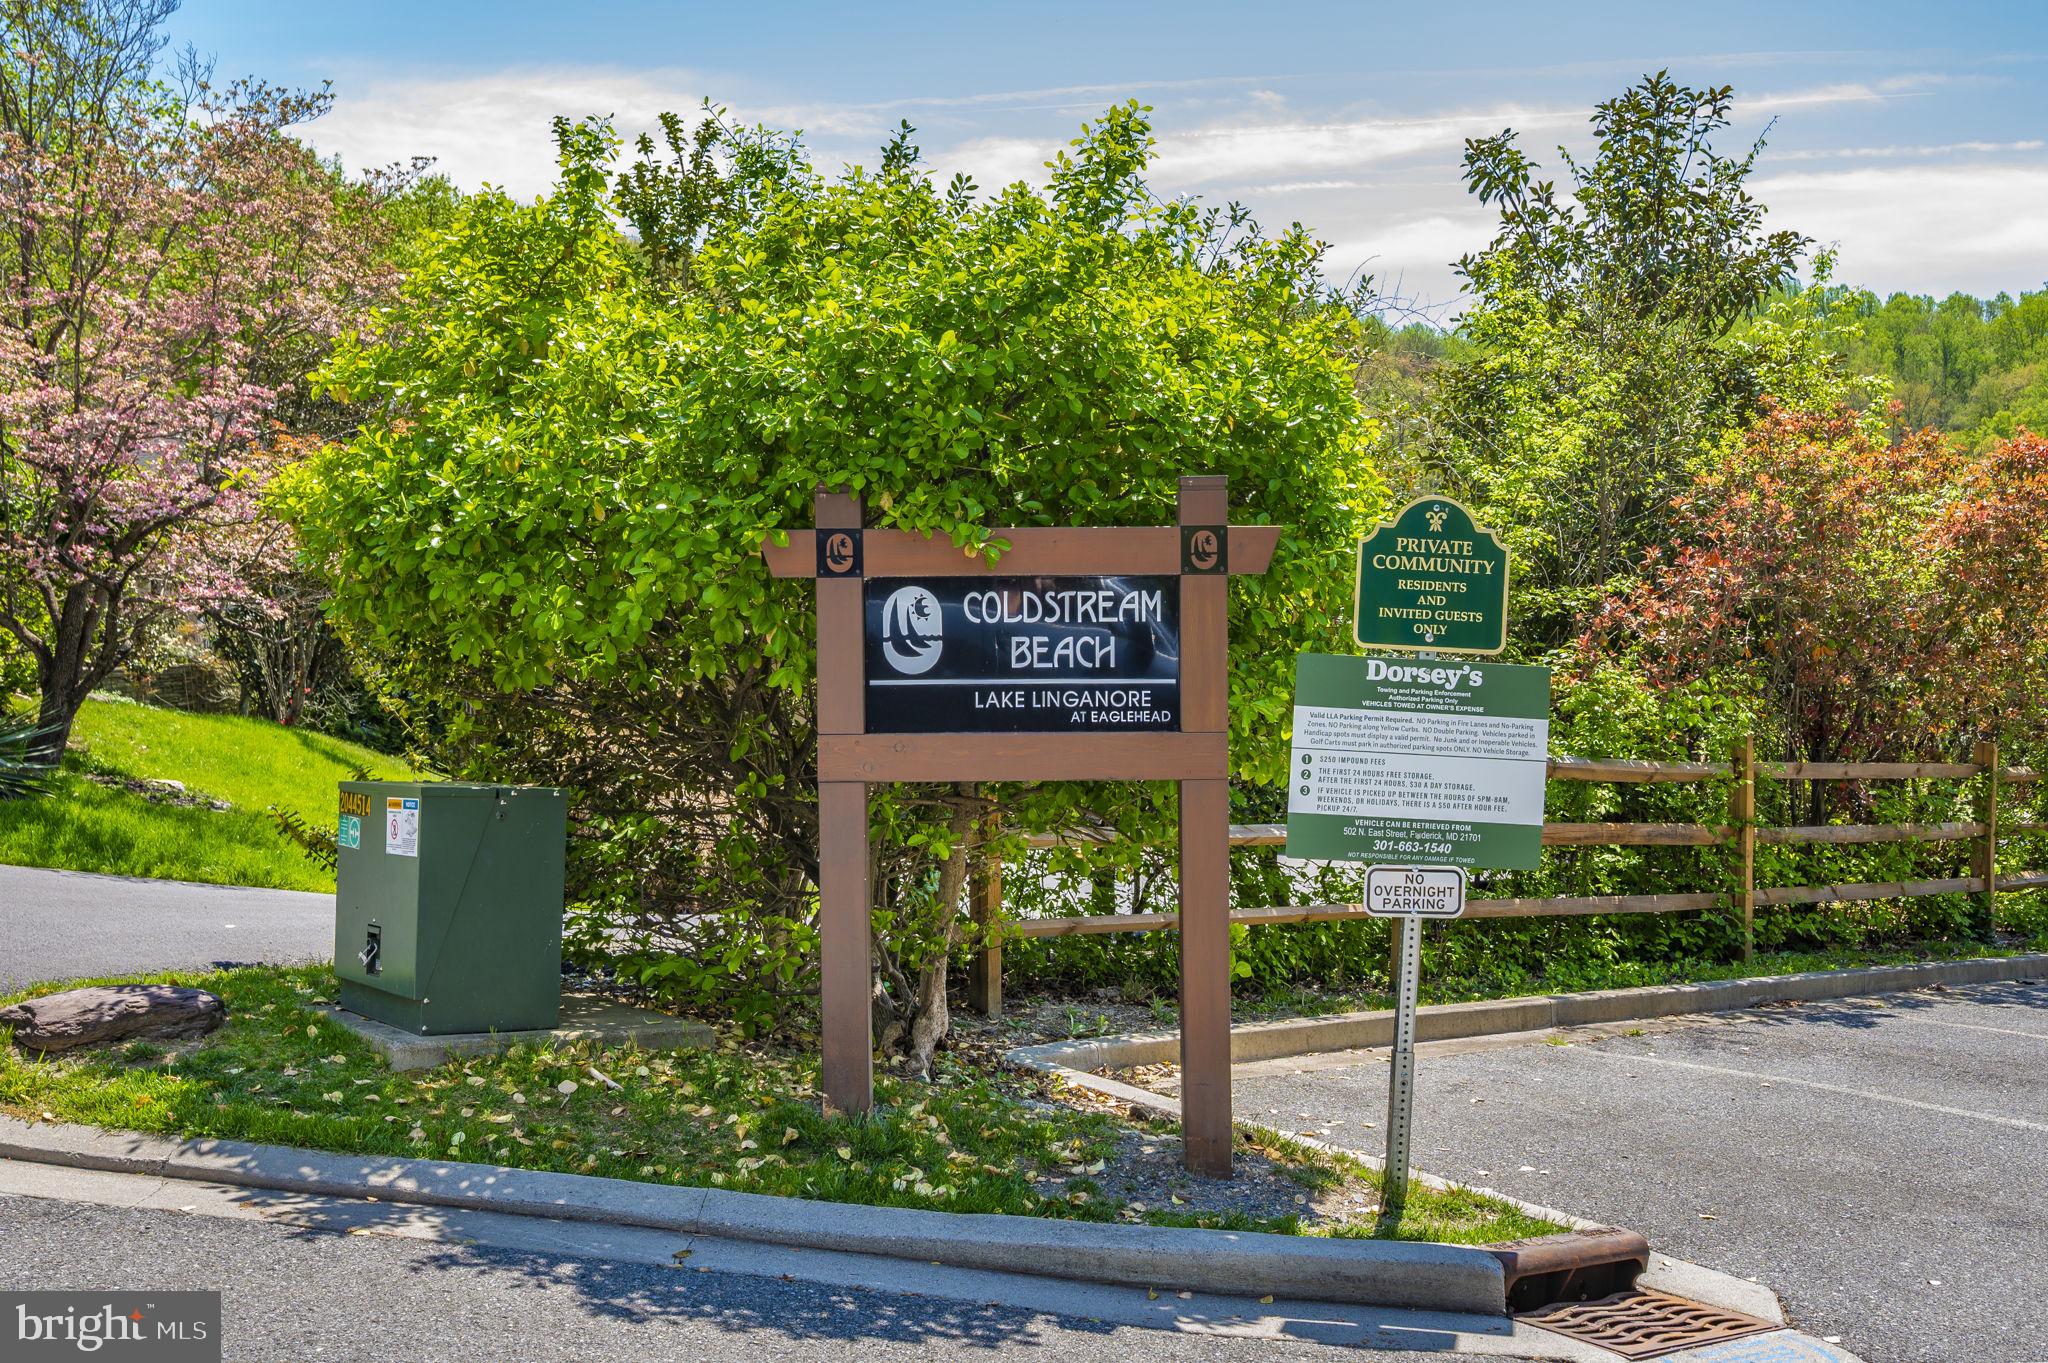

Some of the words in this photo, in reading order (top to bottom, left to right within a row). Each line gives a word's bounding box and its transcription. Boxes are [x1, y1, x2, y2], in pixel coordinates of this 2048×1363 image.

[1396, 538, 1473, 556] PRIVATE
[1373, 555, 1495, 575] COMMUNITY
[1398, 579, 1467, 592] RESIDENTS
[1417, 596, 1446, 606] AND
[963, 590, 1161, 624] COLDSTREAM
[1379, 608, 1432, 619] INVITED
[1435, 611, 1483, 622] GUESTS
[1413, 624, 1447, 635] ONLY
[1011, 636, 1115, 669] BEACH
[1366, 660, 1483, 690] Dorsey's
[975, 691, 1025, 708] LAKE
[1032, 690, 1151, 708] LINGANORE
[1421, 696, 1443, 704] Parking
[1394, 701, 1415, 709] TOWED
[1426, 703, 1454, 711] OWNER'S
[1071, 711, 1086, 722] AT
[1091, 711, 1171, 722] EAGLEHEAD
[1340, 714, 1362, 722] Parking
[1386, 716, 1414, 724] Required.
[1501, 723, 1534, 731] No-Parking
[1340, 722, 1363, 730] Parking
[1380, 741, 1411, 749] authorized
[1412, 743, 1435, 752] parking
[1479, 739, 1510, 747] Inoperable
[1303, 771, 1309, 779] 2
[1399, 791, 1428, 799] BETWEEN
[1316, 804, 1340, 812] PICKUP
[1355, 819, 1384, 827] VEHICLE
[1413, 823, 1450, 831] RETRIEVED
[1452, 824, 1472, 832] FROM
[1343, 827, 1357, 836] 502
[1358, 828, 1366, 836] N.
[1368, 829, 1384, 837] East
[1446, 833, 1458, 841] MD
[1460, 834, 1481, 842] 21701
[1373, 839, 1452, 854] 301-663-1540
[1360, 852, 1398, 860] RESPONSIBLE
[1405, 874, 1424, 885] NO
[1374, 885, 1454, 898] OVERNIGHT
[1383, 898, 1445, 909] PARKING
